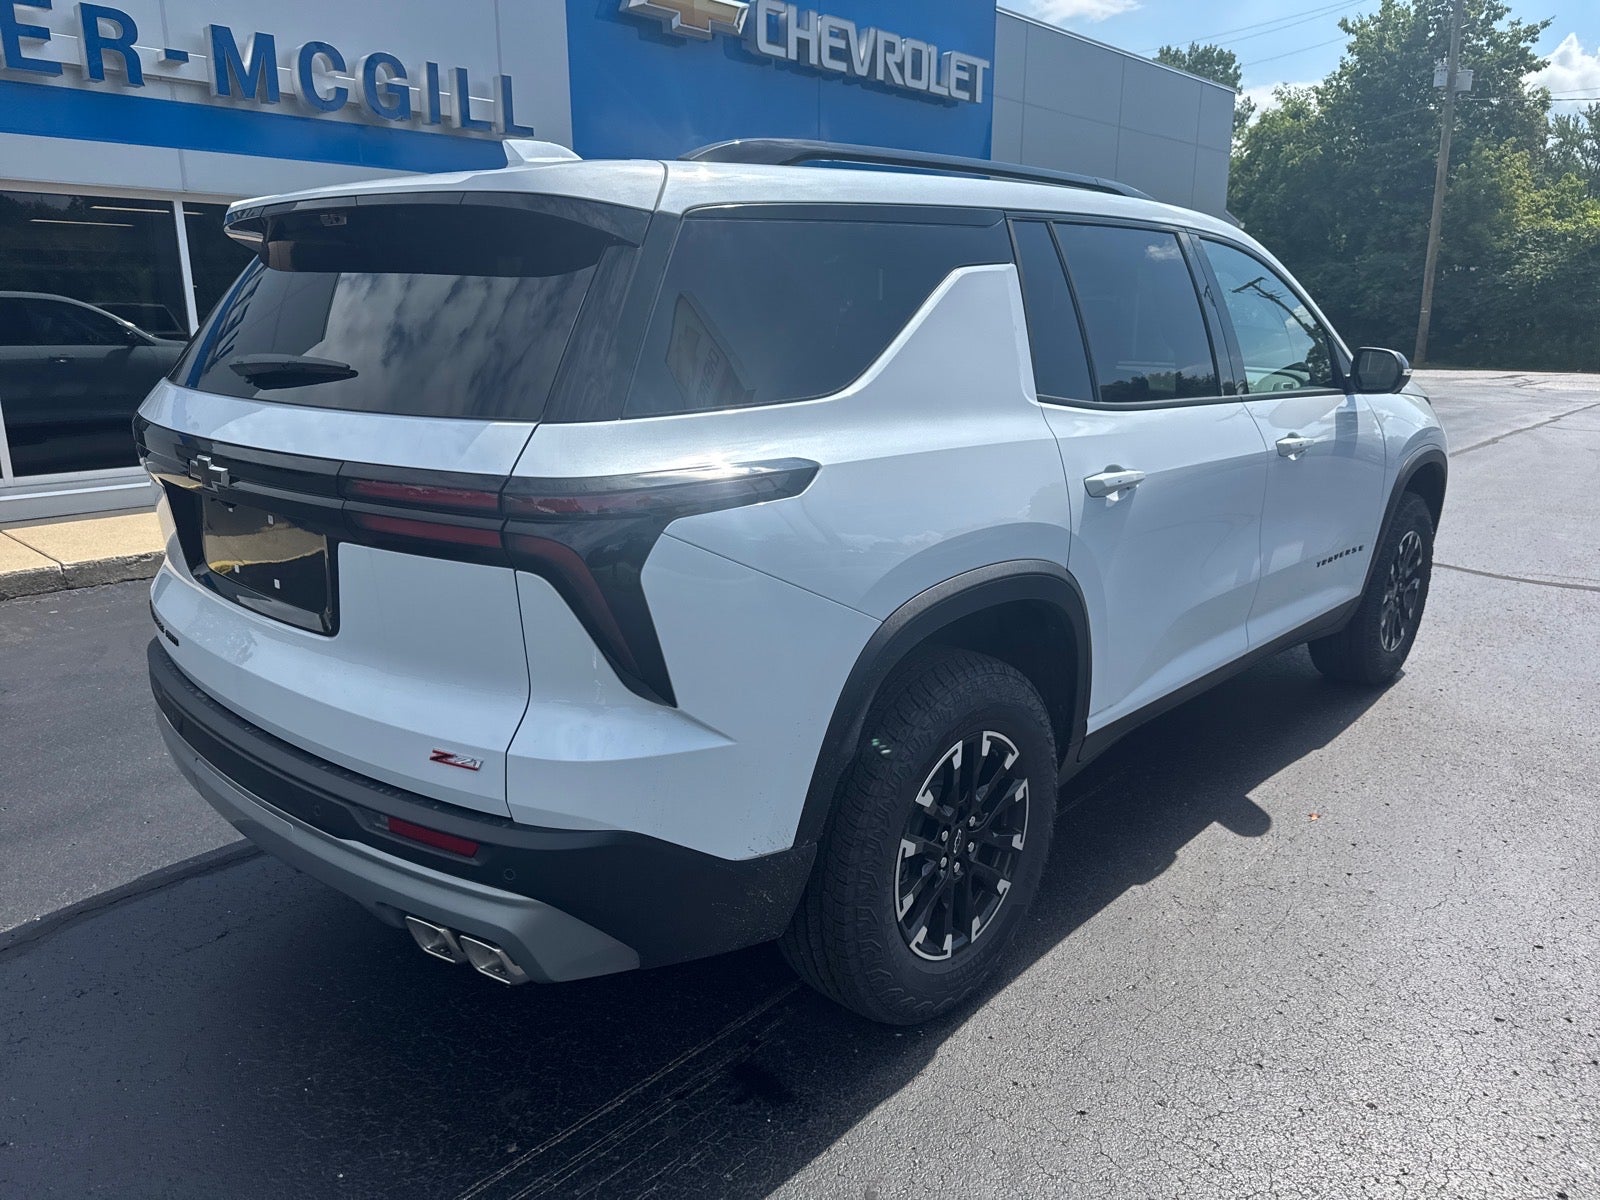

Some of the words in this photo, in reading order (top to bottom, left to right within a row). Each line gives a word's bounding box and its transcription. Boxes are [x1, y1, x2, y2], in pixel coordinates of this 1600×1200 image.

[754, 0, 990, 103] CHEVROLET
[1316, 545, 1364, 568] TRAVERSE
[429, 748, 483, 771] Z71
